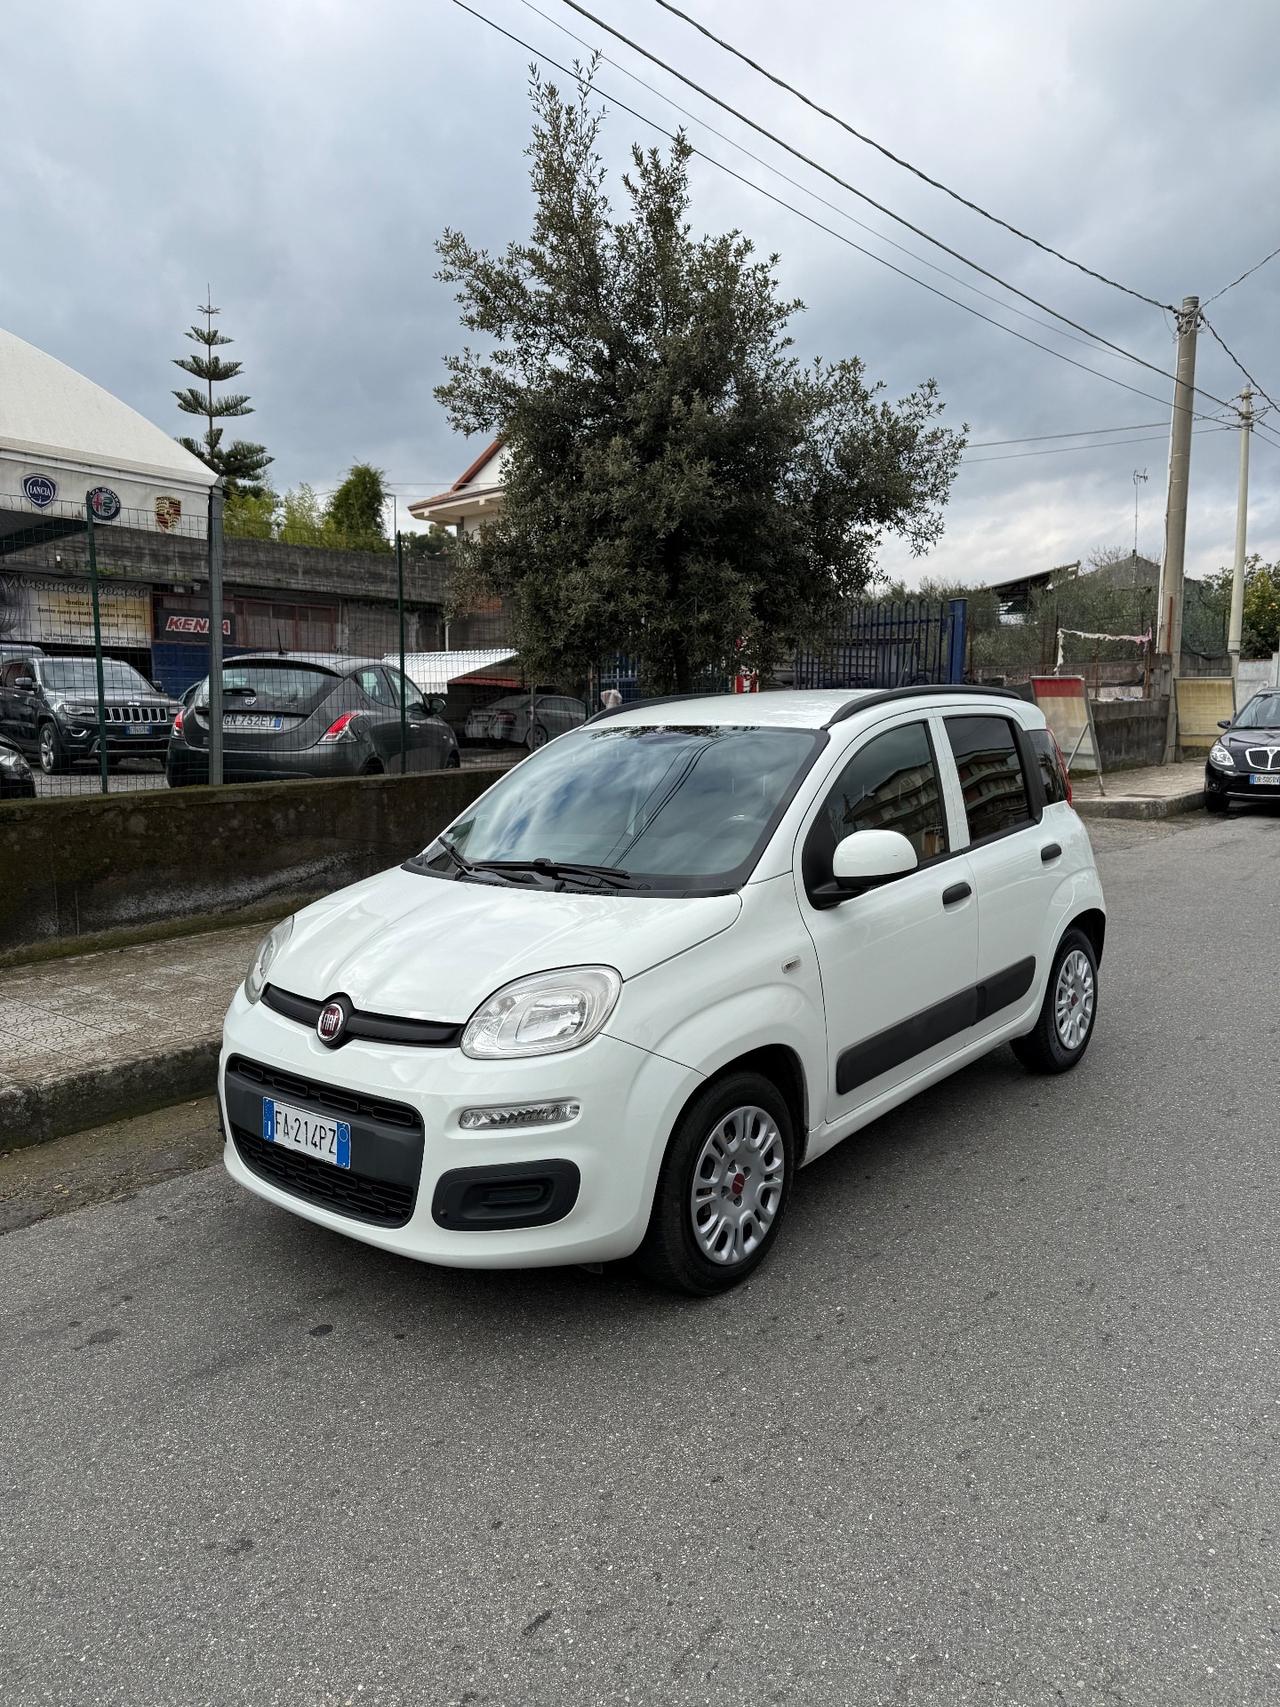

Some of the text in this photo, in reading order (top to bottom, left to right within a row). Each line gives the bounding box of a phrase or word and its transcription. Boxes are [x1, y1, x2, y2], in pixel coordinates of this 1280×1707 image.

[29, 485, 51, 497] LANCIA
[165, 616, 231, 635] KENA
[321, 1013, 339, 1032] FIAT
